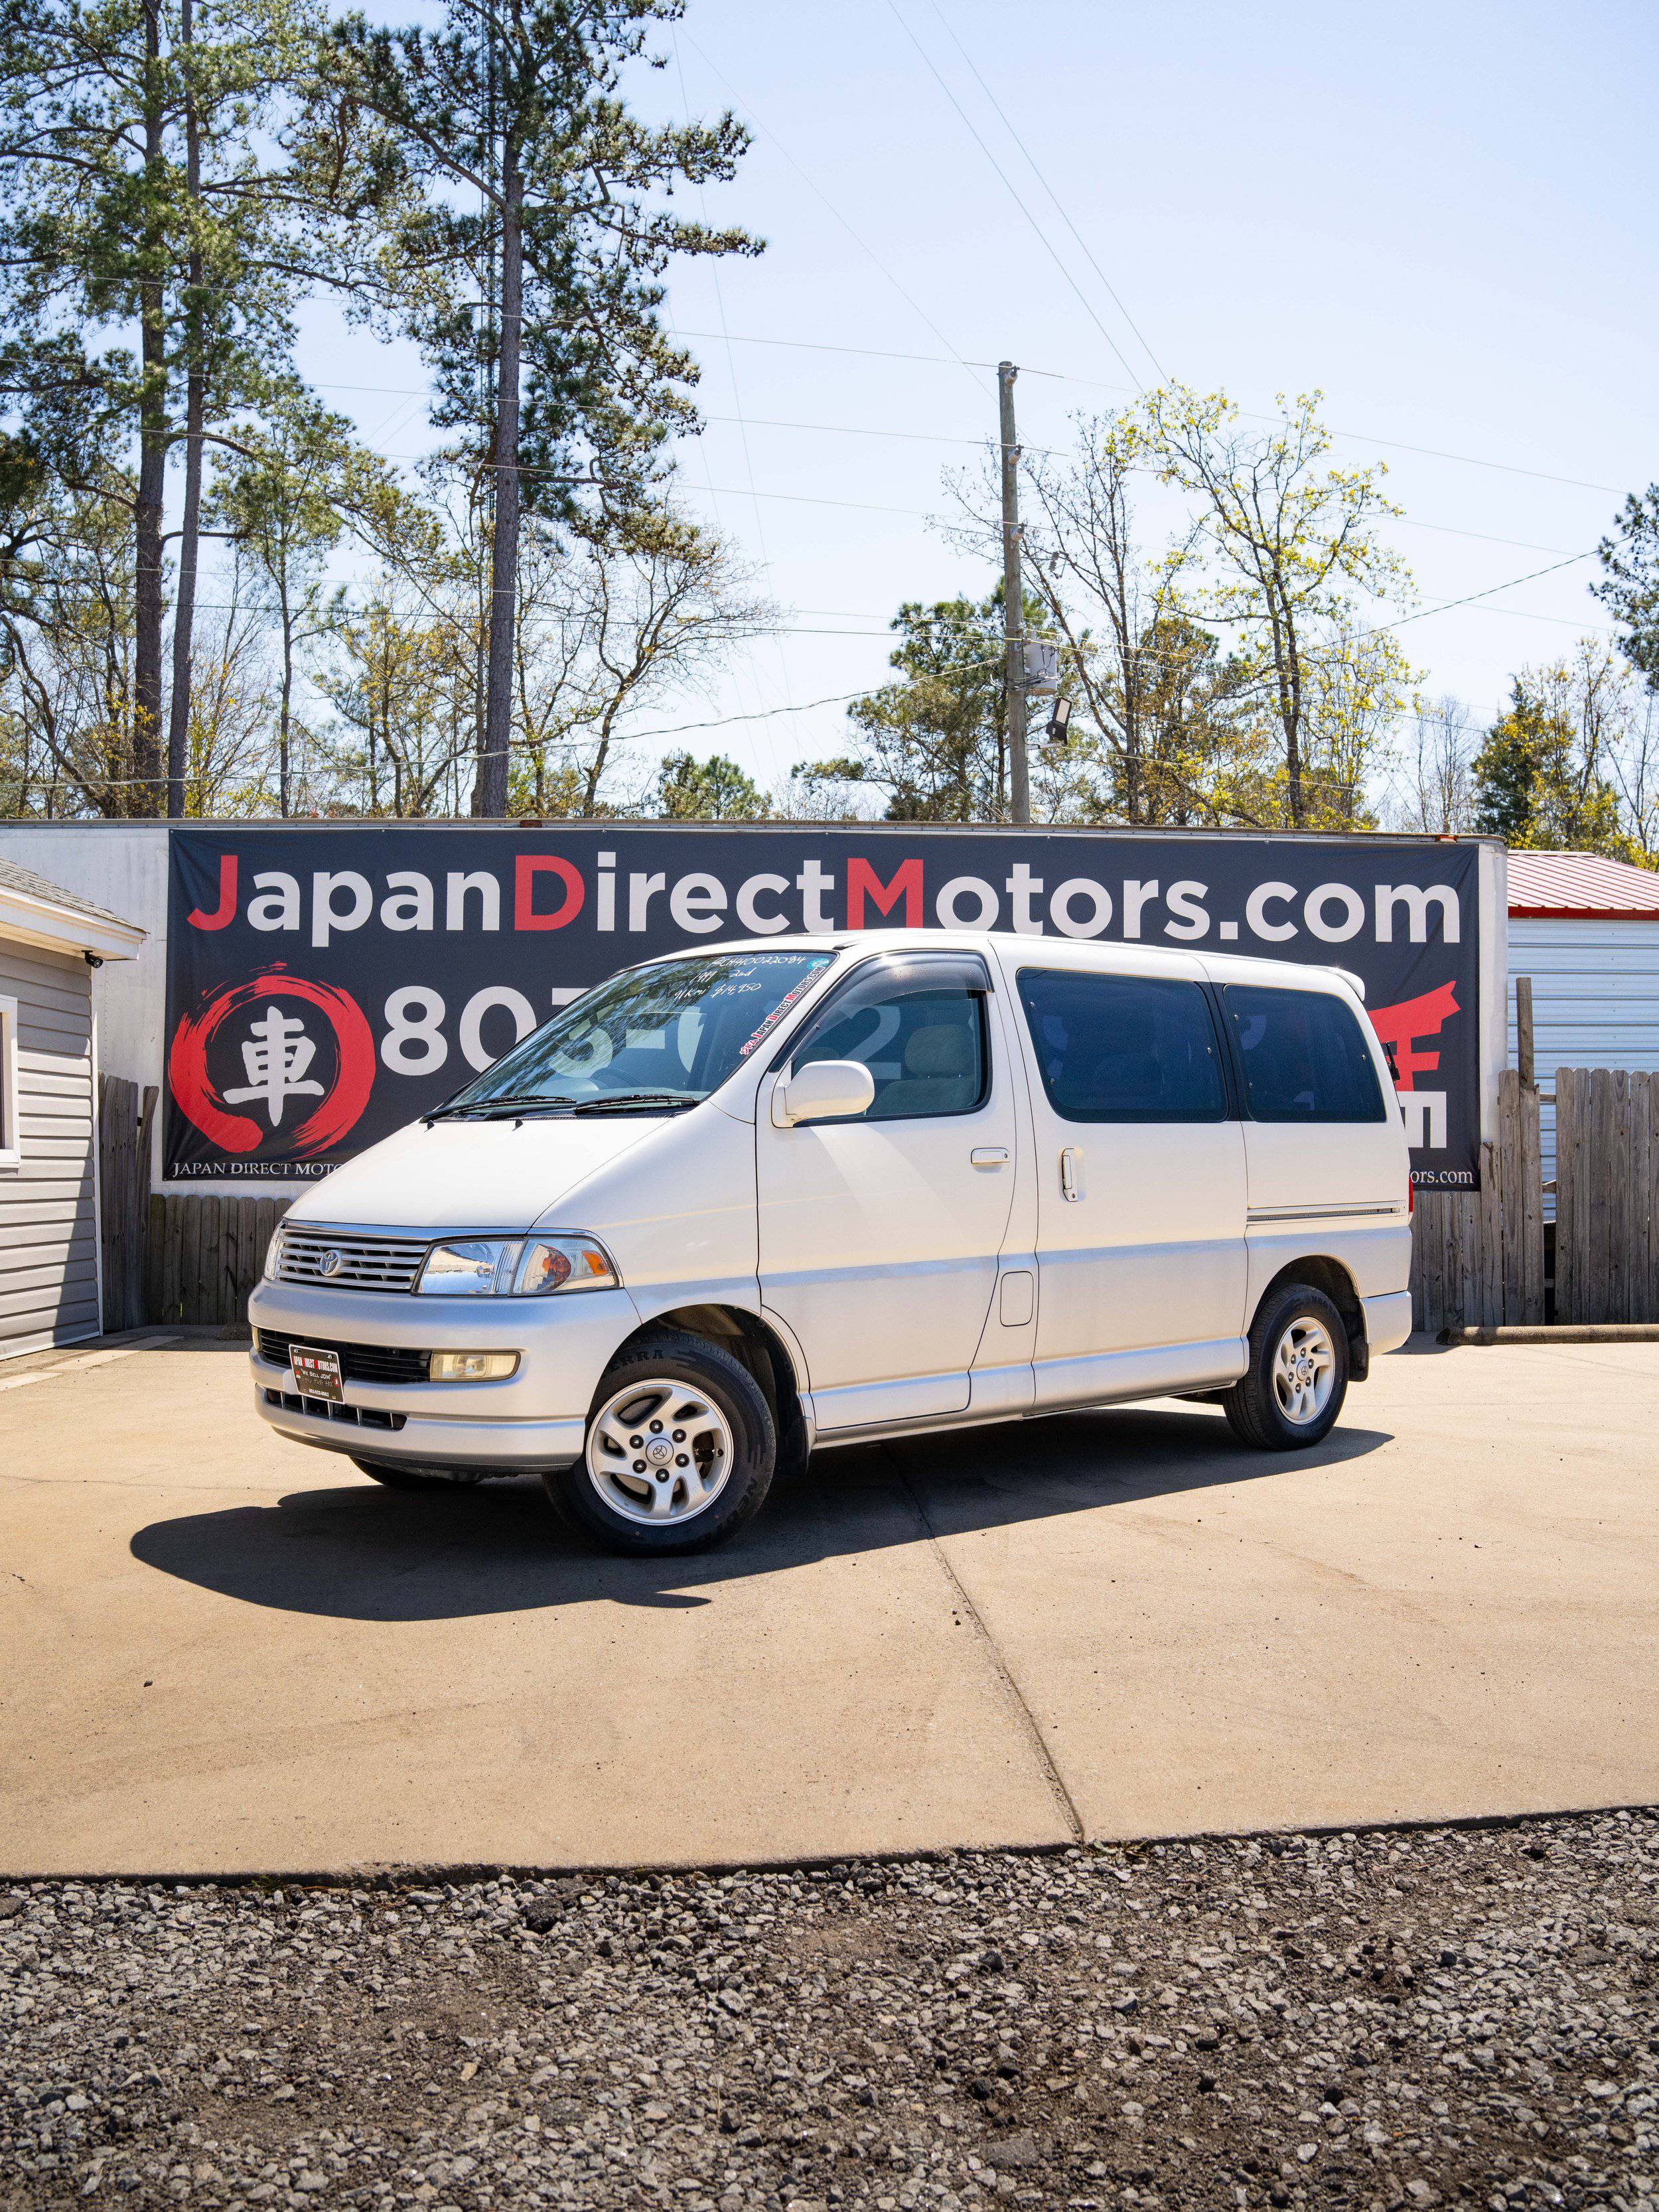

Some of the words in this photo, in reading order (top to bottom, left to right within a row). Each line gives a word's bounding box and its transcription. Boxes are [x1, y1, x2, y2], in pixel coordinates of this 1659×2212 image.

[186, 851, 1460, 947] JapanDirectMotors.com
[689, 970, 717, 983] 1999
[751, 966, 825, 1039] JAPANDIRECTMOTORS.COM
[223, 1005, 325, 1127] 車
[173, 1163, 225, 1177] JAPAN
[231, 1163, 292, 1175] DIRECT
